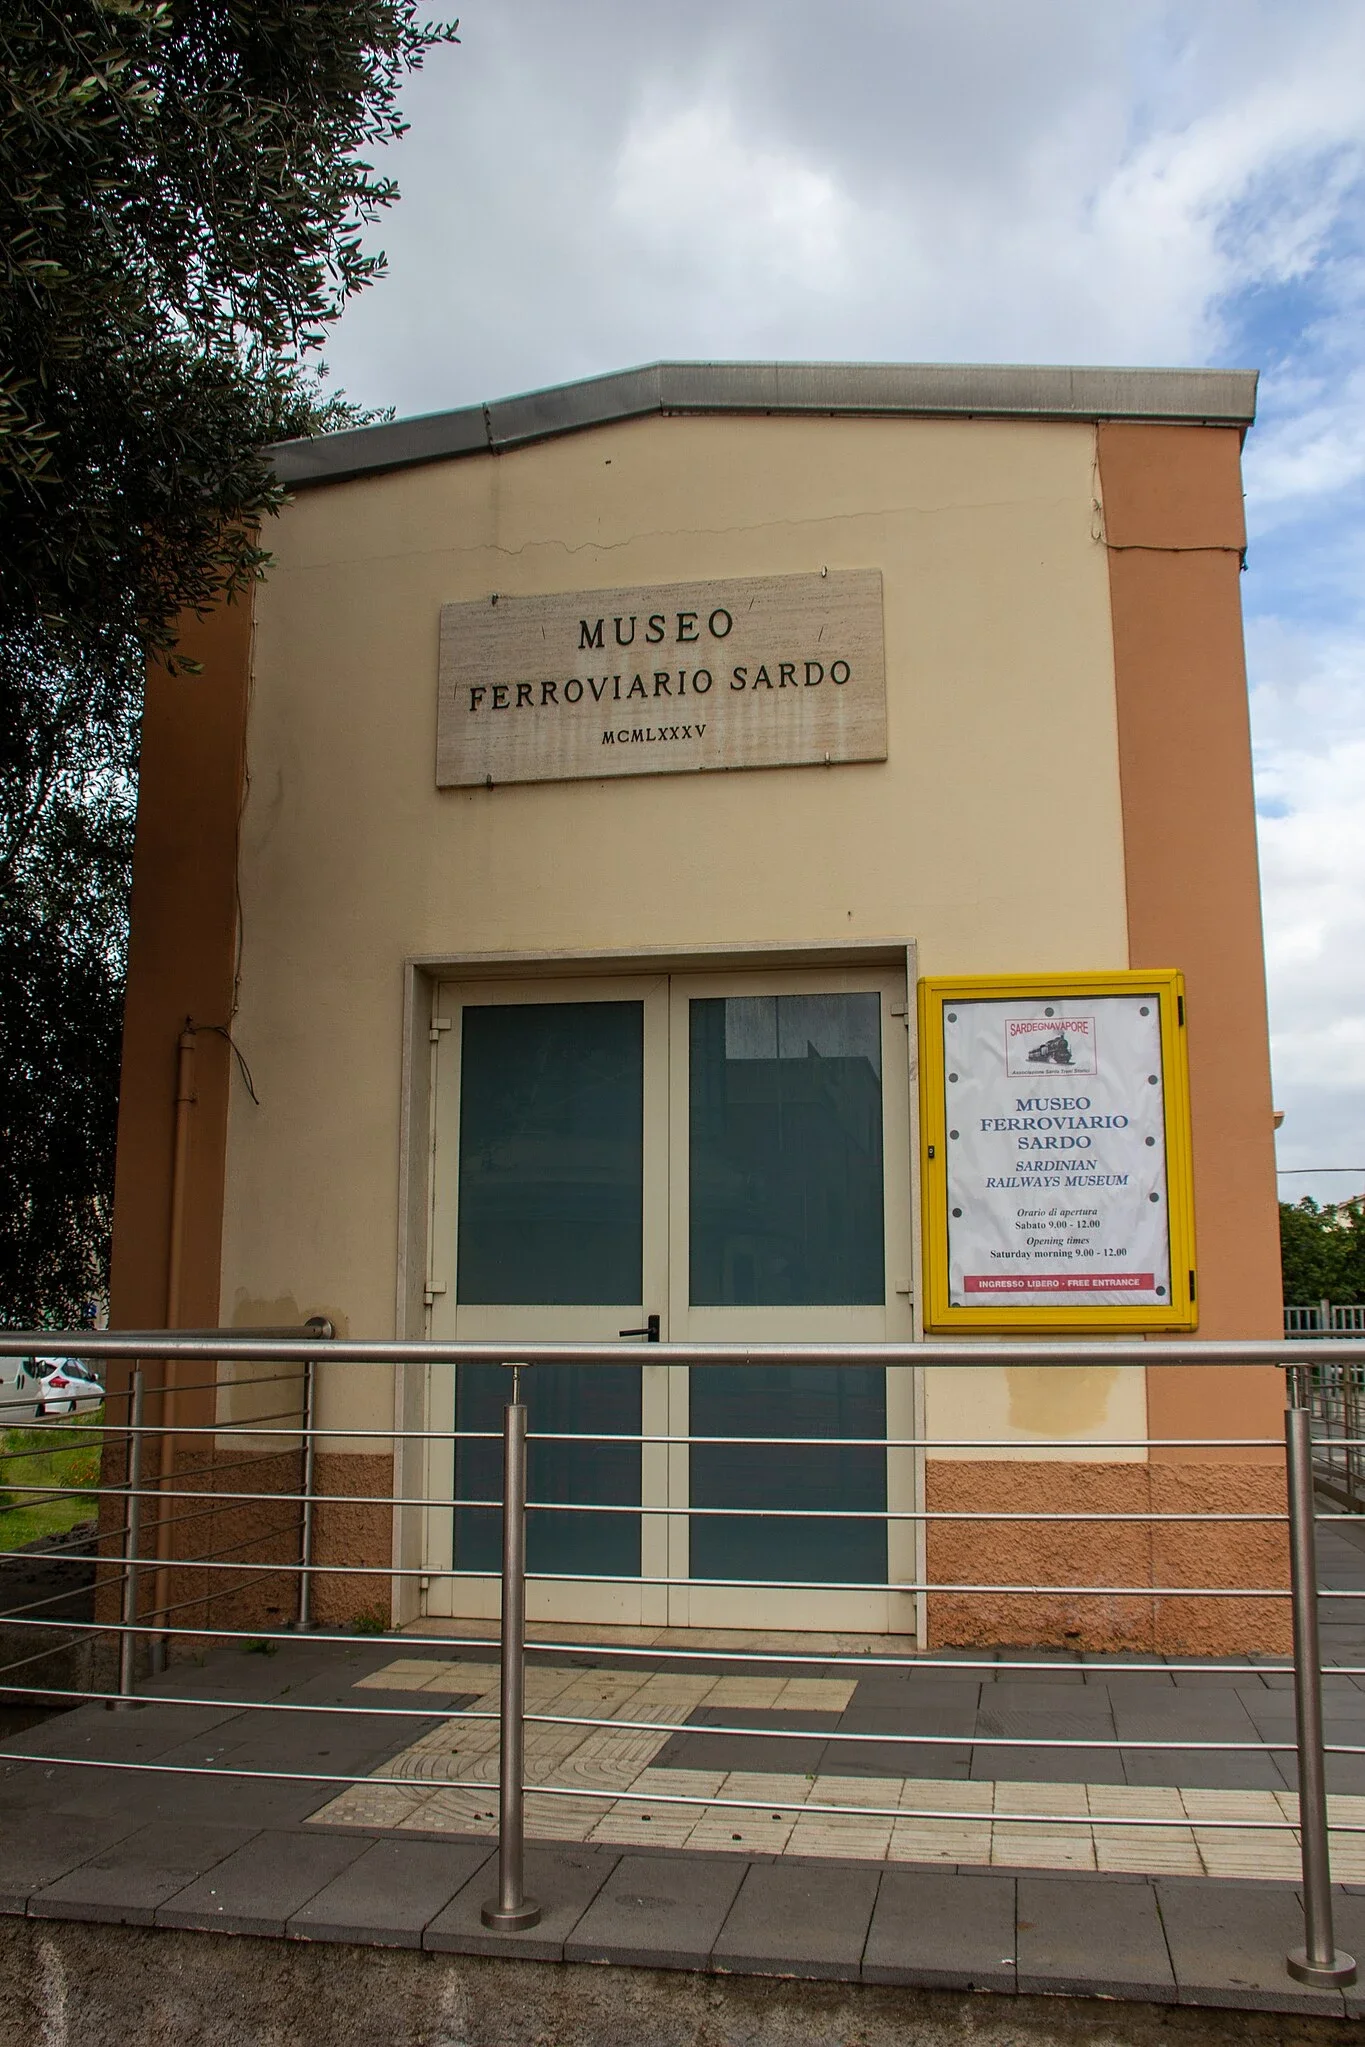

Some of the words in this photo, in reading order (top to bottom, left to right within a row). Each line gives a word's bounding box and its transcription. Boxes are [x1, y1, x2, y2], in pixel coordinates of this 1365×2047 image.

[578, 608, 733, 649] MUSEO
[469, 669, 712, 711] FERROVIARIO
[730, 660, 851, 691] SARDO
[602, 724, 707, 744] MCMLXXXV
[1011, 1022, 1088, 1036] SARDEGNAVAPORE
[1016, 1097, 1090, 1111] MUSEO
[980, 1115, 1128, 1131] FERROVIARIO
[1018, 1136, 1091, 1150] SARDO
[1016, 1160, 1098, 1172] SARDINIAN
[986, 1176, 1060, 1188] RAILWAYS
[1065, 1175, 1128, 1186] MUSEUM
[1017, 1208, 1045, 1217] Orario
[1048, 1208, 1057, 1216] di
[1060, 1208, 1097, 1218] apertura
[1015, 1221, 1046, 1229] Sabato
[1048, 1220, 1067, 1229] 9.00
[1077, 1220, 1100, 1228] 12.00
[1026, 1237, 1063, 1246] Opening
[1067, 1236, 1089, 1245] times
[990, 1250, 1031, 1259] Saturday
[1034, 1249, 1073, 1259] morning
[1075, 1249, 1094, 1257] 9.00
[1104, 1248, 1127, 1256] 12.00
[979, 1280, 1024, 1288] INGRESSO
[1068, 1279, 1089, 1287] FREE
